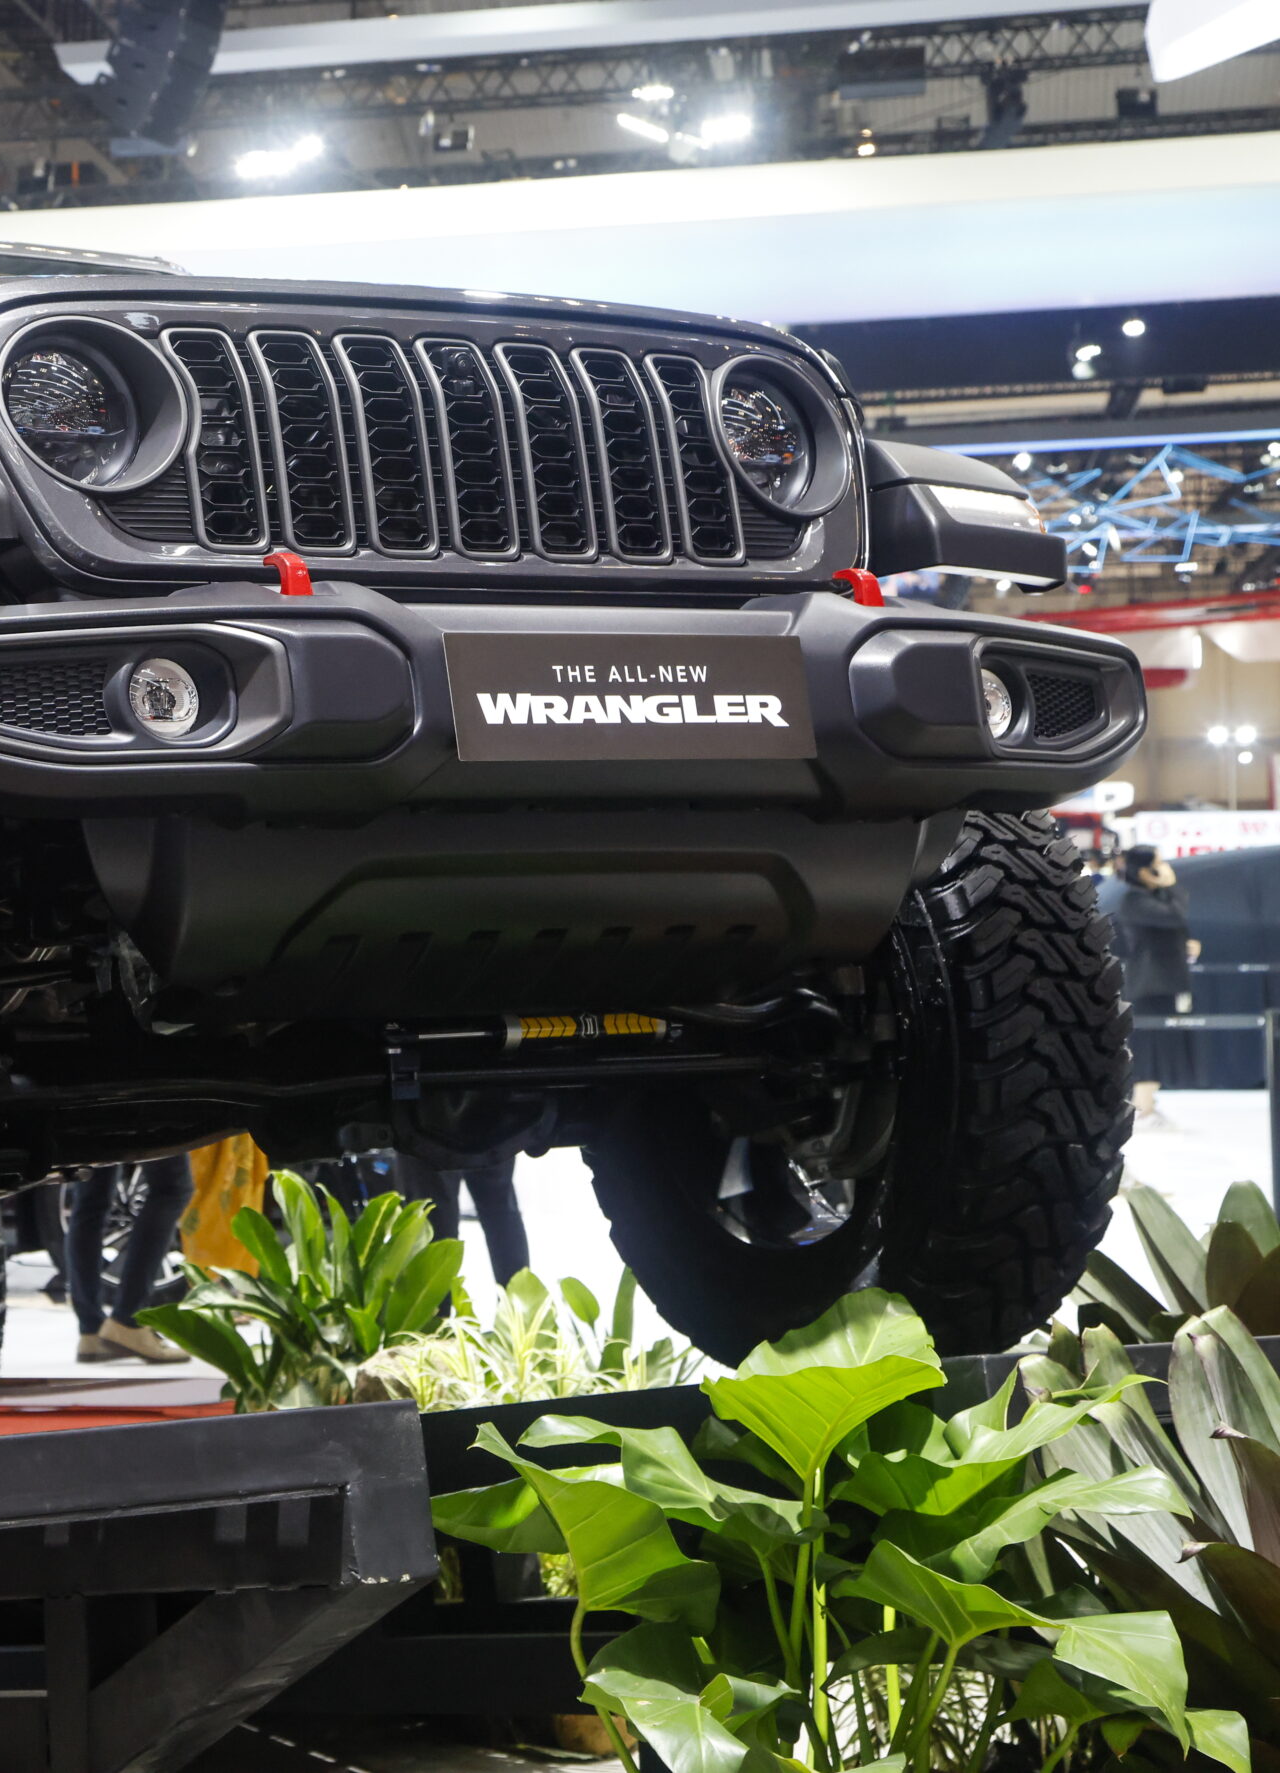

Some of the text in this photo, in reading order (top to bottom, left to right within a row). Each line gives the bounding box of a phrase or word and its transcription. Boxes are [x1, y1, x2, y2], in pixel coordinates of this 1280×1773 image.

[552, 665, 707, 683] THE ALL-NEW
[476, 693, 790, 727] WRANGLER
